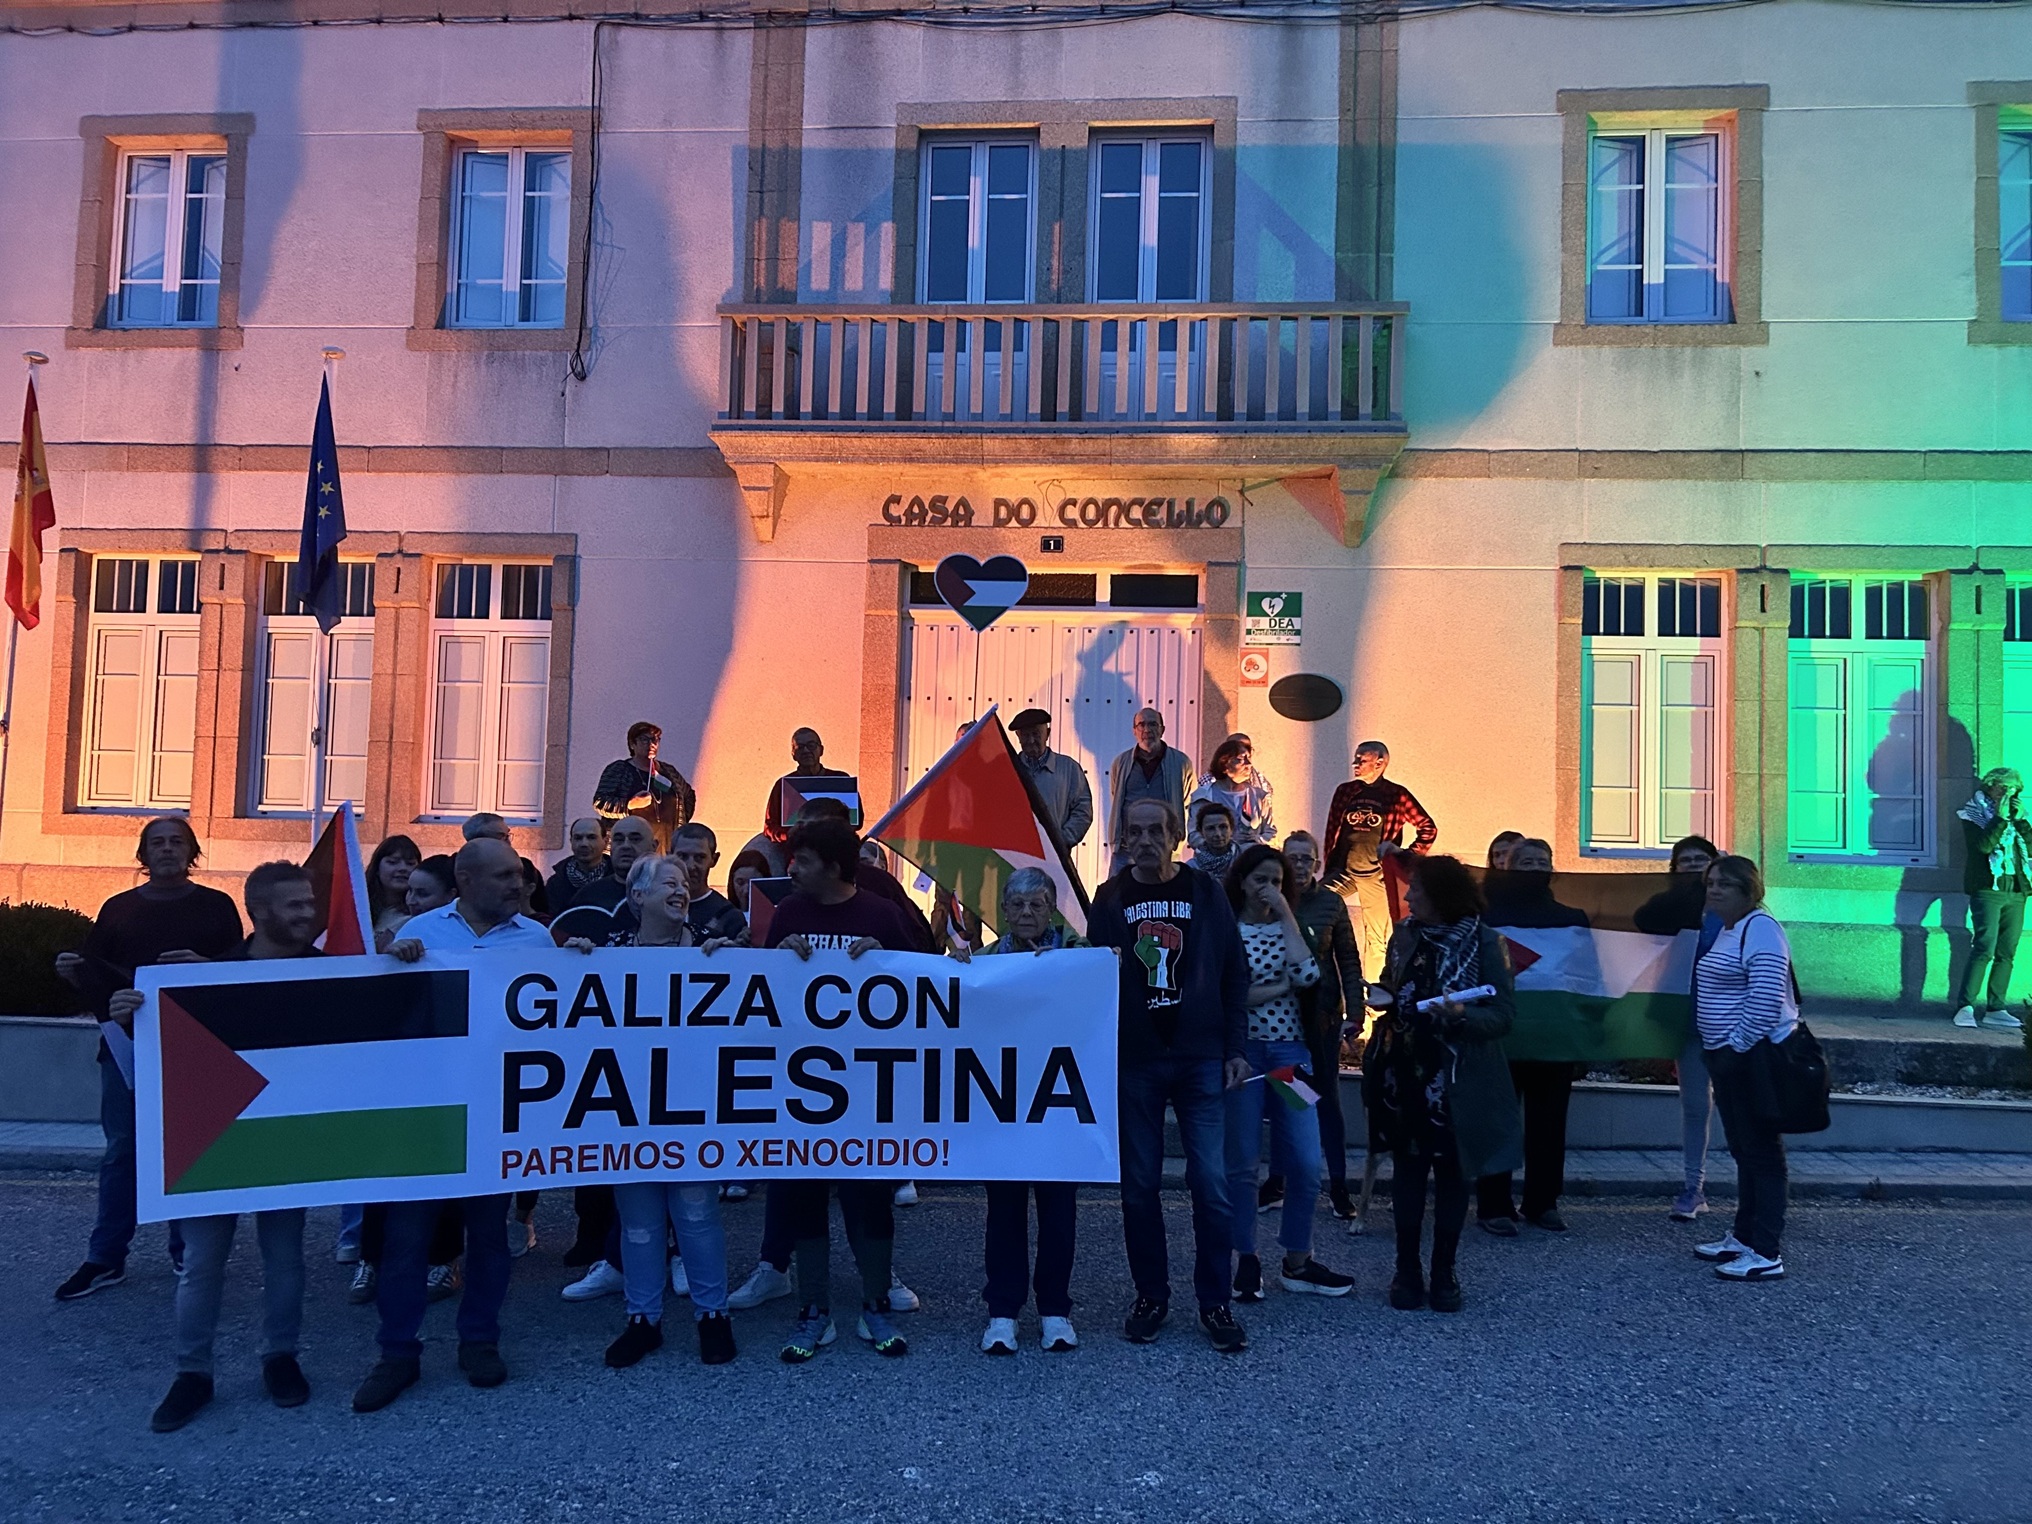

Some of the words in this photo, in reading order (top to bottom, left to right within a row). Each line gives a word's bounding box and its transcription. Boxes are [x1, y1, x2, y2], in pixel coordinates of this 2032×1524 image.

[882, 494, 975, 527] CASA
[993, 497, 1038, 528] DO
[1058, 496, 1231, 528] CONCELLO
[1049, 540, 1054, 550] 1
[1251, 628, 1296, 637] Desfibrilador
[1268, 618, 1295, 629] DEA
[504, 973, 782, 1030] GALIZA
[804, 974, 960, 1030] CON
[501, 1046, 1097, 1133] PALESTINA
[501, 1140, 685, 1179] PAREMOS
[697, 1140, 725, 1169] O
[735, 1138, 949, 1168] XENOCIDIO!
